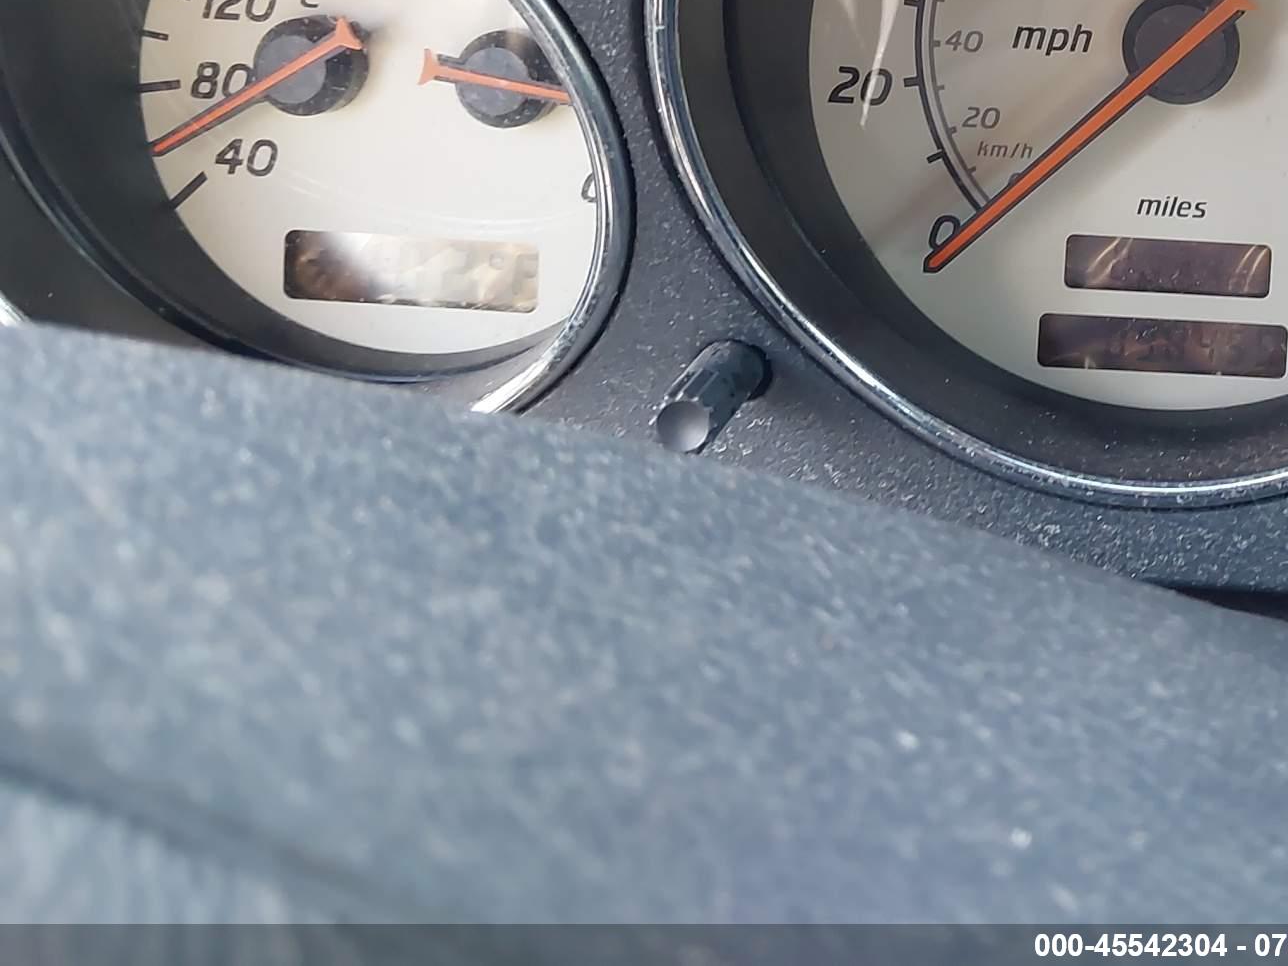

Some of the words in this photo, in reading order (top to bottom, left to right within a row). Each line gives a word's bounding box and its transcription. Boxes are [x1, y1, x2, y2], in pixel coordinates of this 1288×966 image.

[945, 30, 983, 52] 40
[1012, 24, 1093, 56] mph
[191, 62, 255, 99] 80
[828, 66, 893, 106] 20
[962, 107, 1000, 129] 20
[215, 139, 278, 176] 40
[977, 140, 1033, 160] km/h
[1137, 196, 1207, 218] miles
